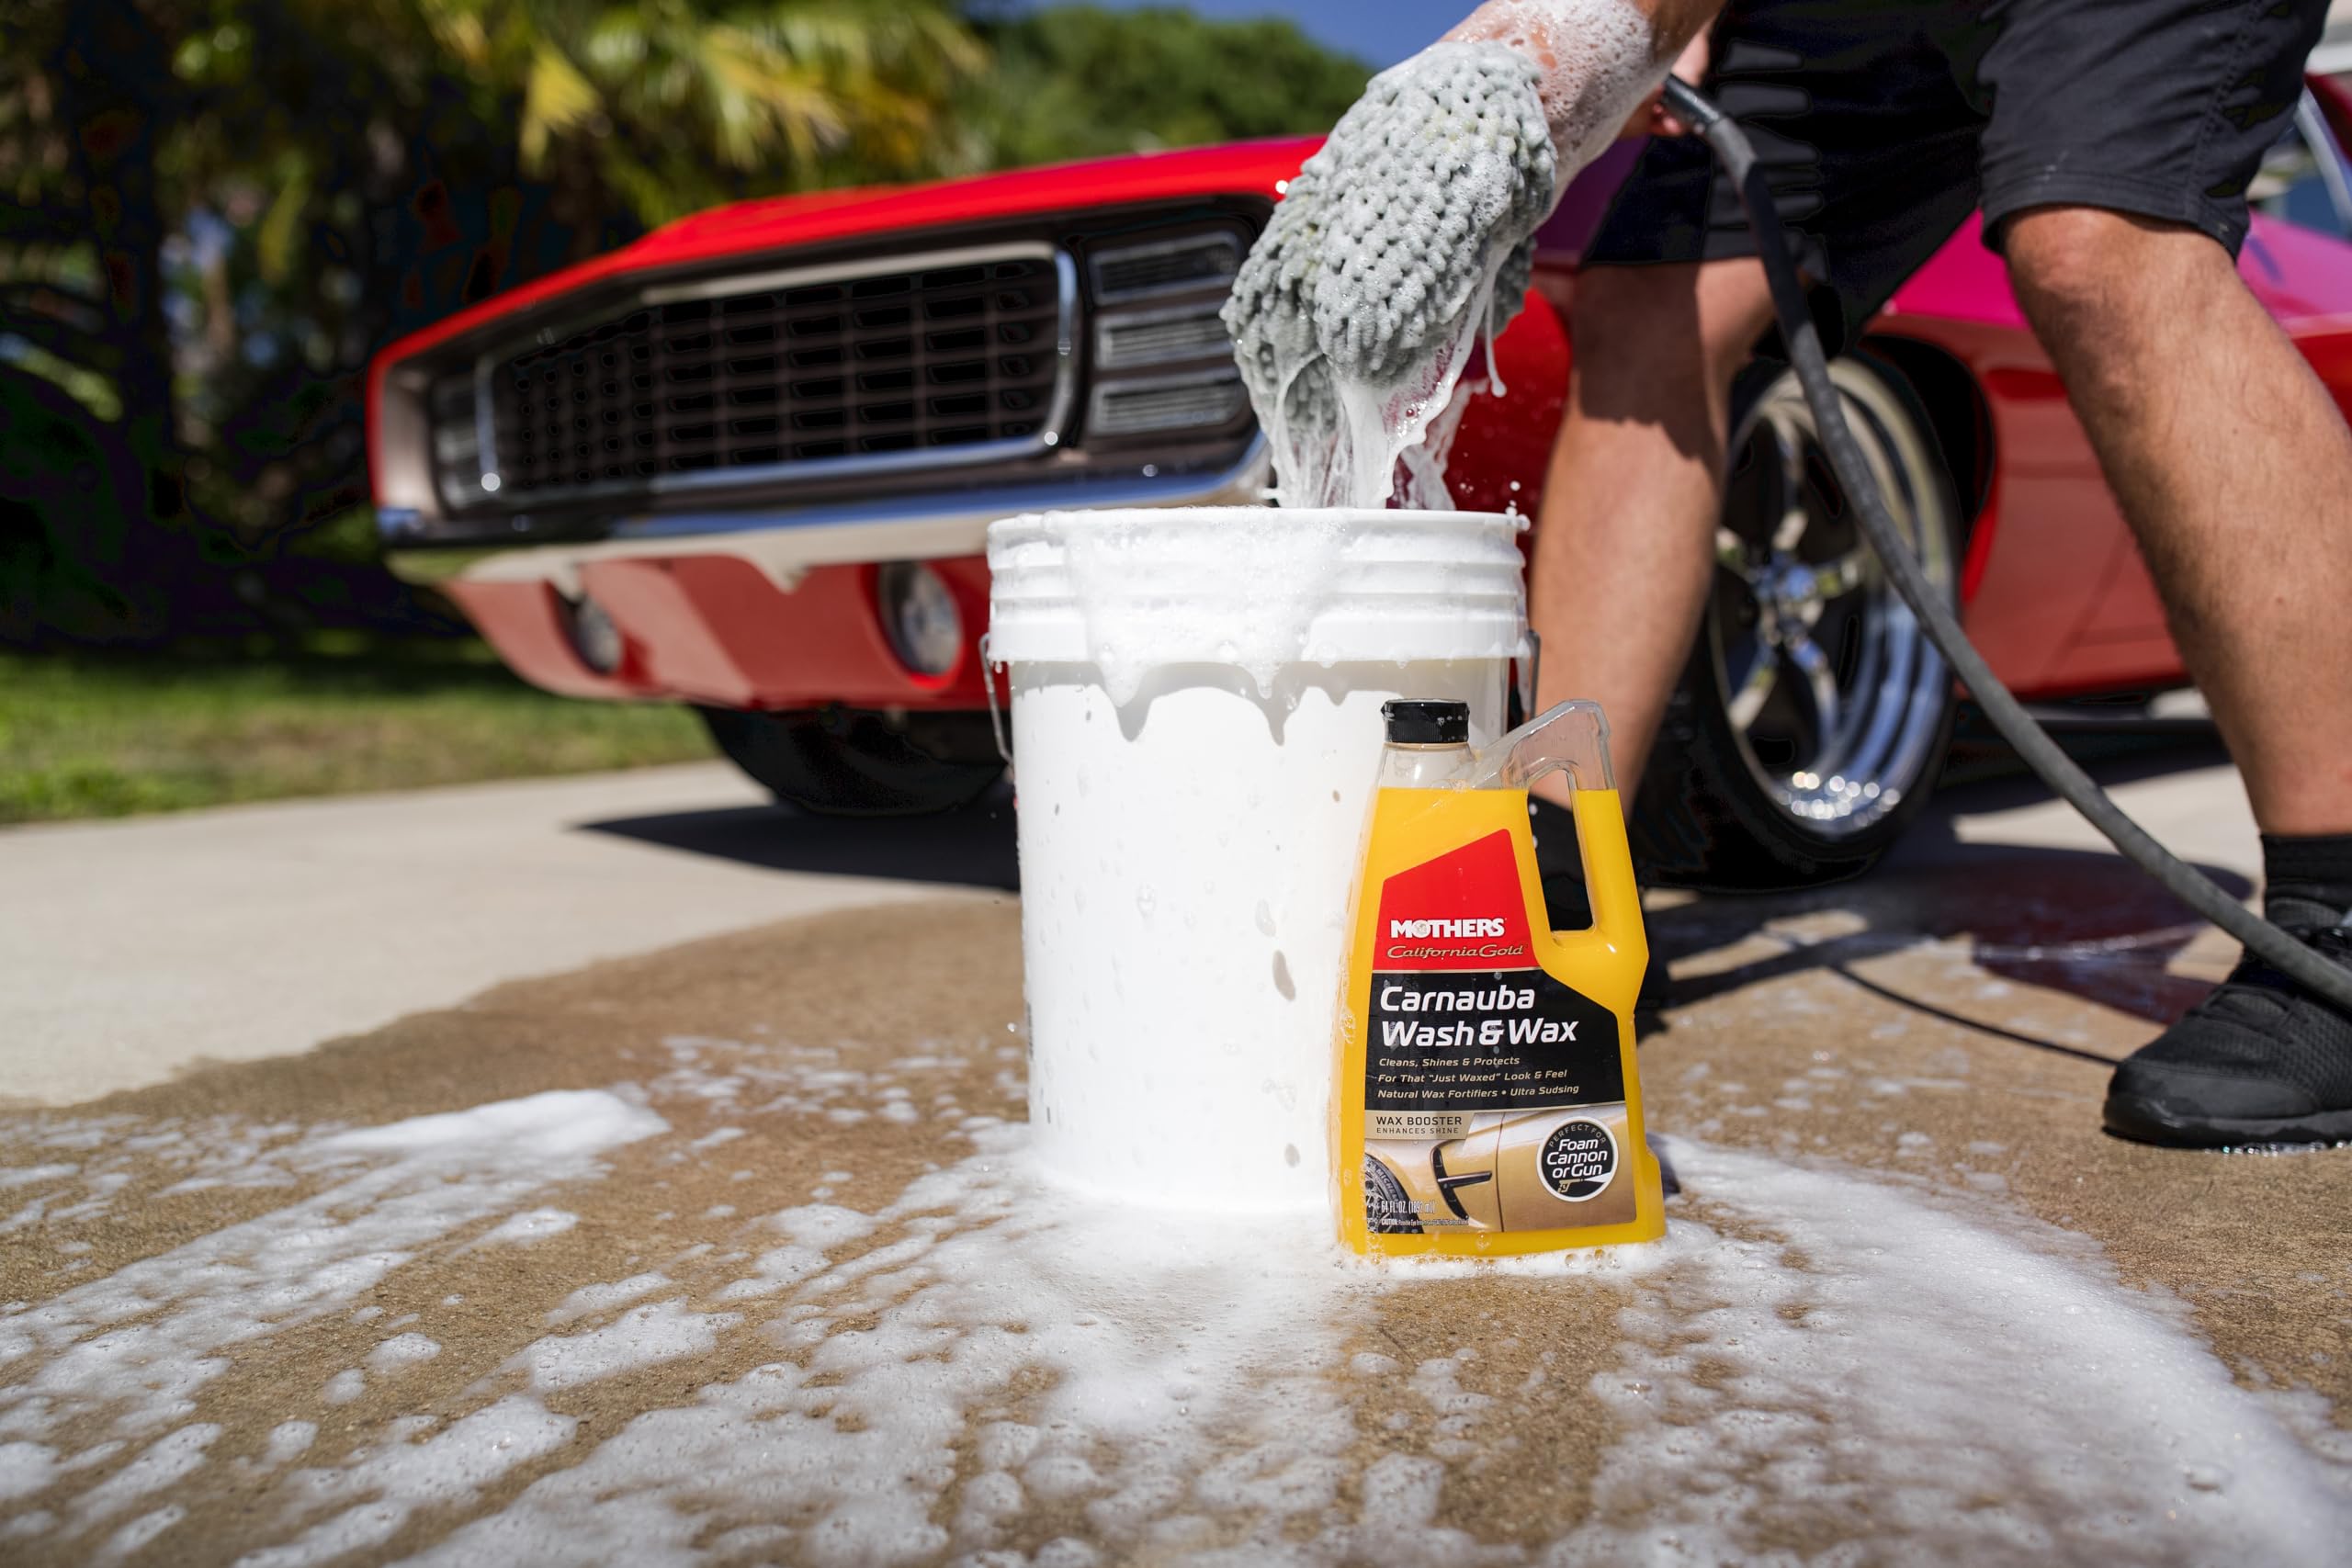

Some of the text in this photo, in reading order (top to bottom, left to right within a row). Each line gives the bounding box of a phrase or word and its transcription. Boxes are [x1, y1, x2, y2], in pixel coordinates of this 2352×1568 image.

[1391, 919, 1505, 938] MOTHERS
[1386, 944, 1524, 958] California Gold
[1380, 985, 1535, 1011] Carnauba
[1379, 1056, 1521, 1067] Cleans, Shines & Protects
[1378, 1074, 1396, 1082] For
[1400, 1074, 1426, 1082] That
[1504, 1072, 1532, 1081] Look
[1534, 1070, 1543, 1079] &
[1545, 1069, 1567, 1078] Feel
[1378, 1085, 1579, 1099] Natural Wax Fortifiers Ultra Sudsing
[1375, 1116, 1463, 1126] WAX BOOSTER
[1549, 1124, 1606, 1146] PERFECT FOR
[1559, 1139, 1598, 1151] Foam
[1547, 1151, 1608, 1165] Cannon
[1552, 1163, 1602, 1179] or Gun
[1381, 1201, 1388, 1213] 64
[1390, 1201, 1398, 1213] FL.
[1398, 1201, 1408, 1213] OZ.
